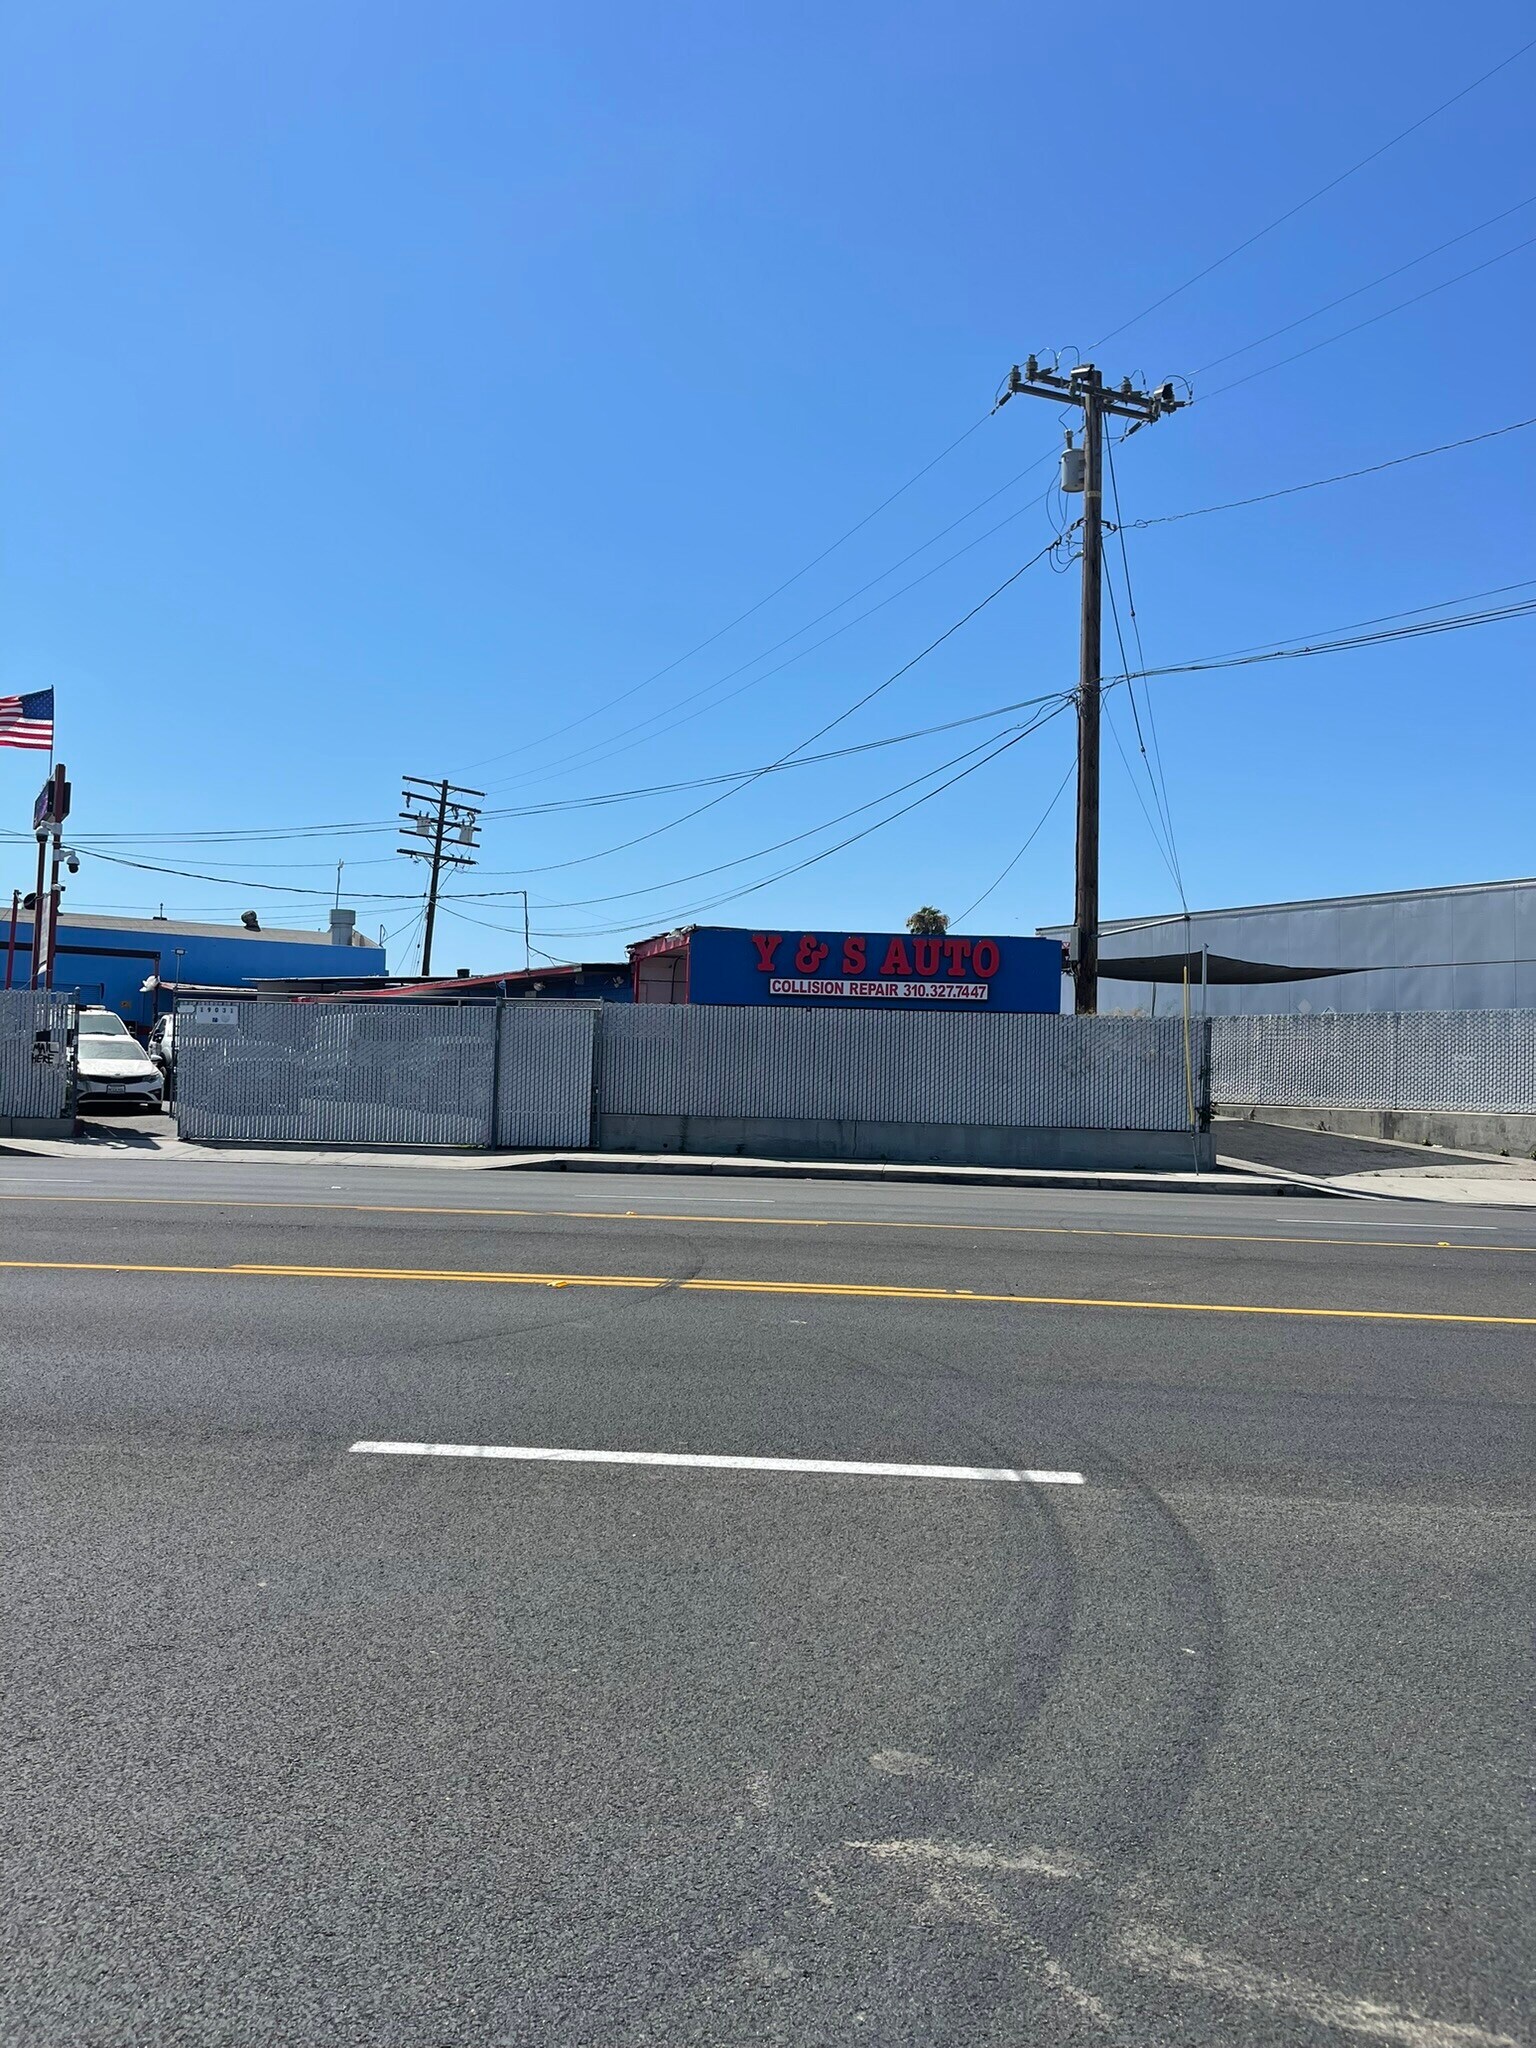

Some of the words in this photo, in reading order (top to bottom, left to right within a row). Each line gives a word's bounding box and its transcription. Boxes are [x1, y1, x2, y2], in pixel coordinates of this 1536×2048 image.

[752, 933, 782, 971] Y
[795, 934, 829, 973] &
[842, 936, 867, 974] S
[879, 937, 1000, 978] AUTO
[772, 979, 844, 995] COLLISION
[850, 982, 899, 996] REPAIR
[903, 983, 987, 998] 310.327.7447
[32, 1042, 59, 1054] MAIL
[32, 1053, 54, 1064] HERE
